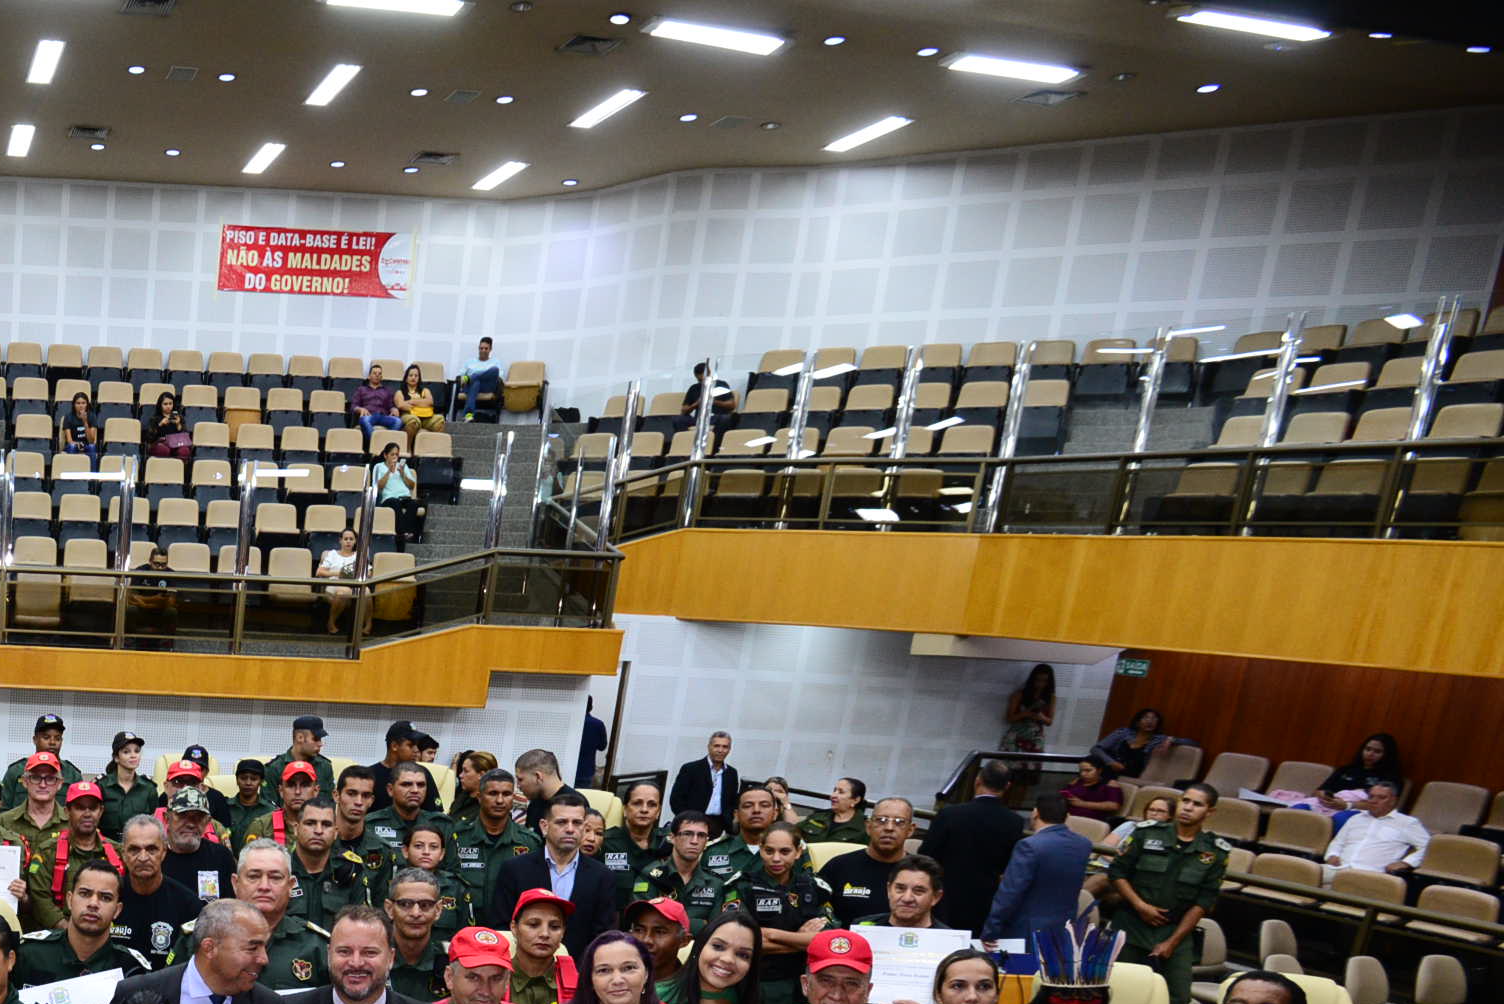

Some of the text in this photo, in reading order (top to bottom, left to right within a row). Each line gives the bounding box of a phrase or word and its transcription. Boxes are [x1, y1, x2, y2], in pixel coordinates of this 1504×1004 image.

[226, 230, 375, 250] PISO E DATA-BASE É LEI!
[226, 246, 371, 272] NÃO ÀS MALDADES
[244, 273, 350, 293] DO GOVERNO!
